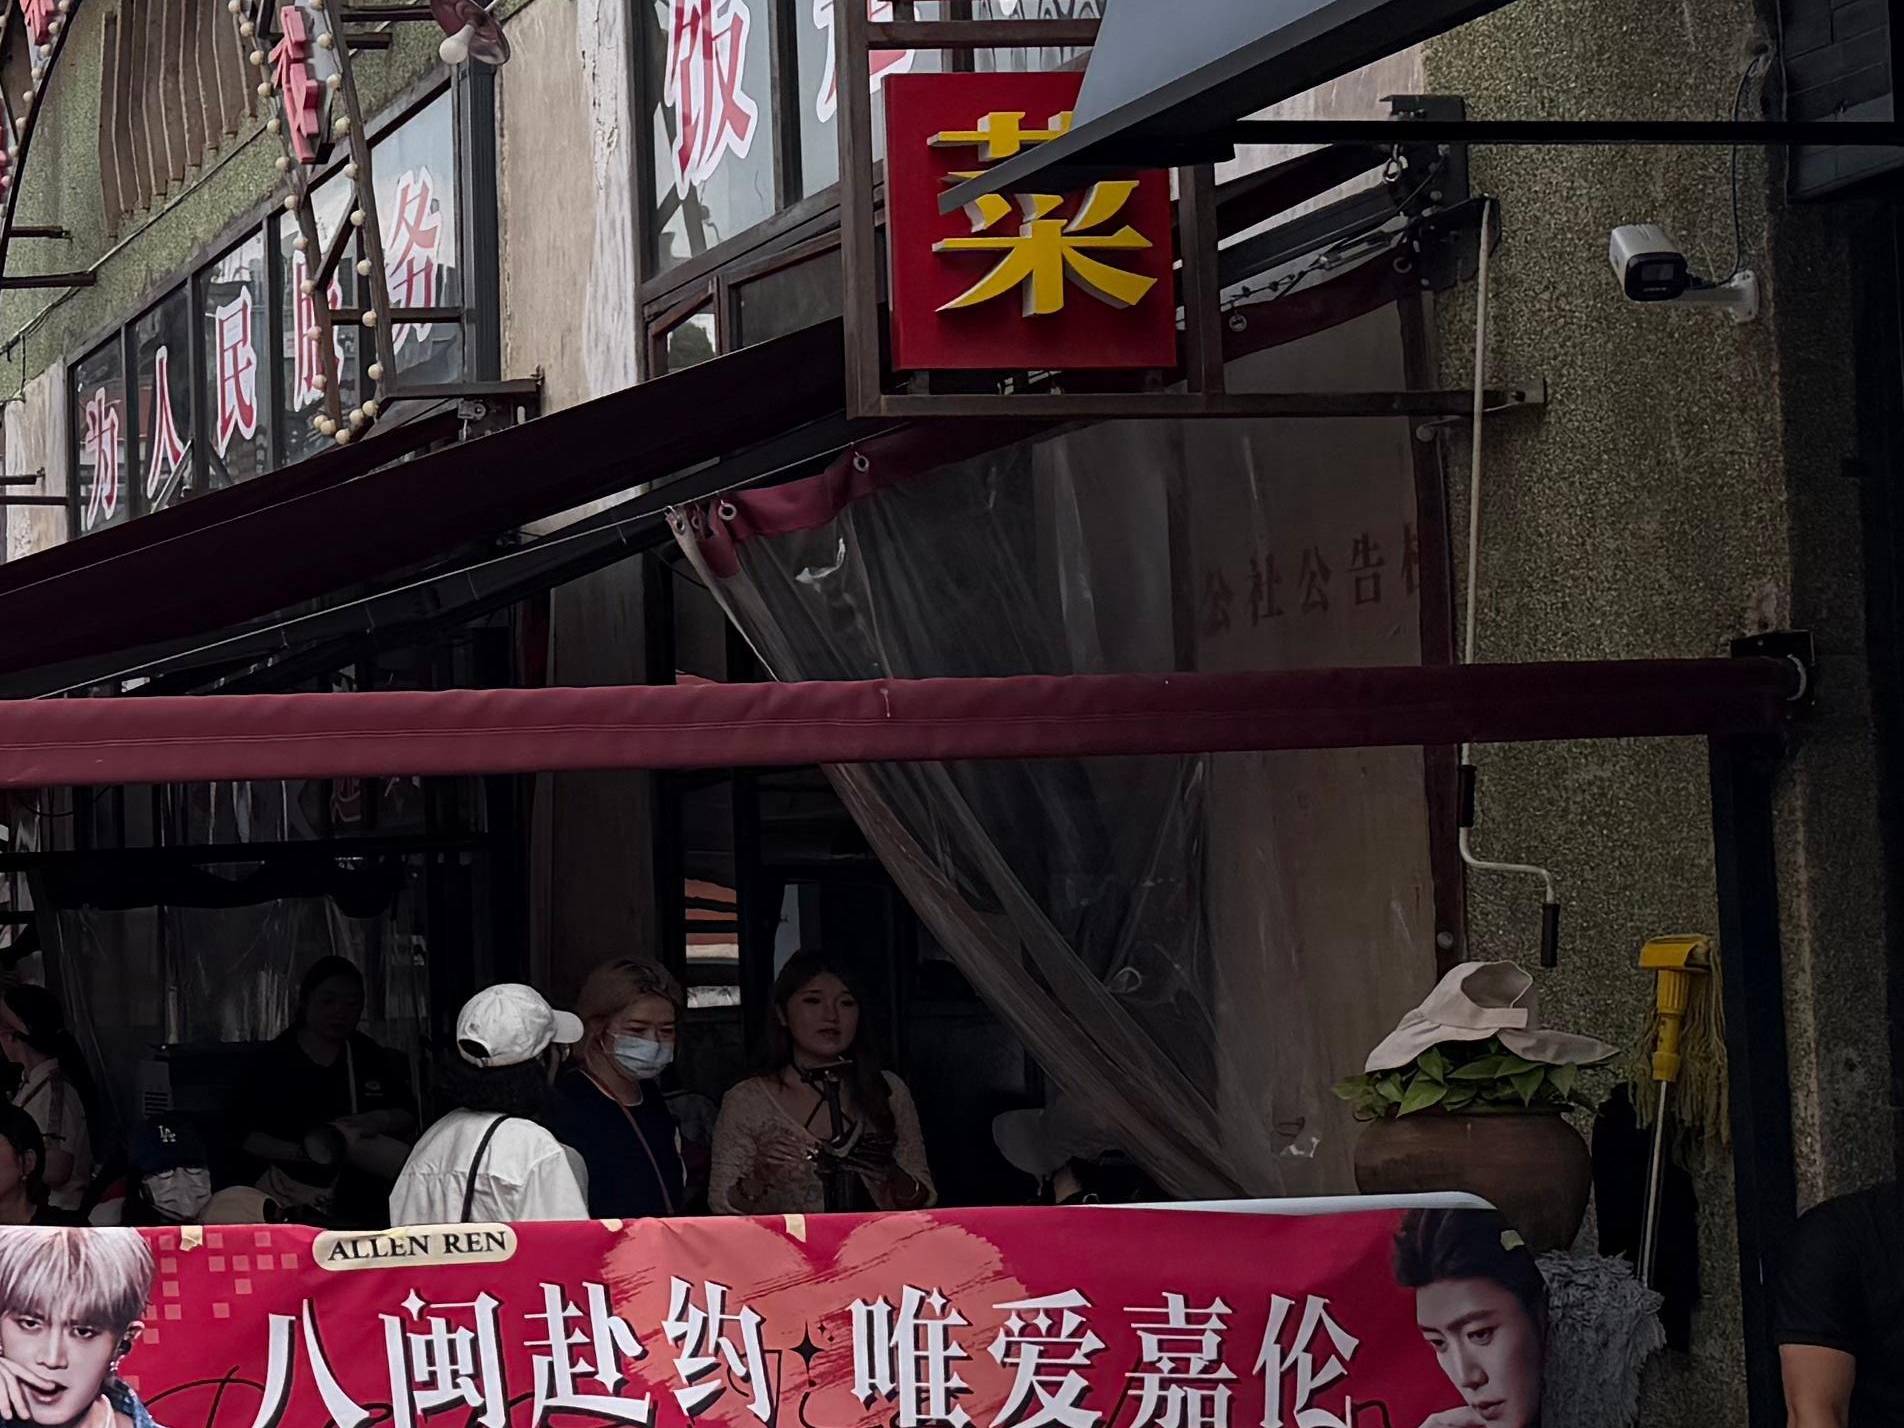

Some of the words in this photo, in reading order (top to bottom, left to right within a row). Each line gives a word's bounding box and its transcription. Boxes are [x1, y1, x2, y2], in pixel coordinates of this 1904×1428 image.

[87, 166, 443, 531] 为人民服务
[326, 1232, 432, 1263] ALLEN
[442, 1230, 509, 1256] REN
